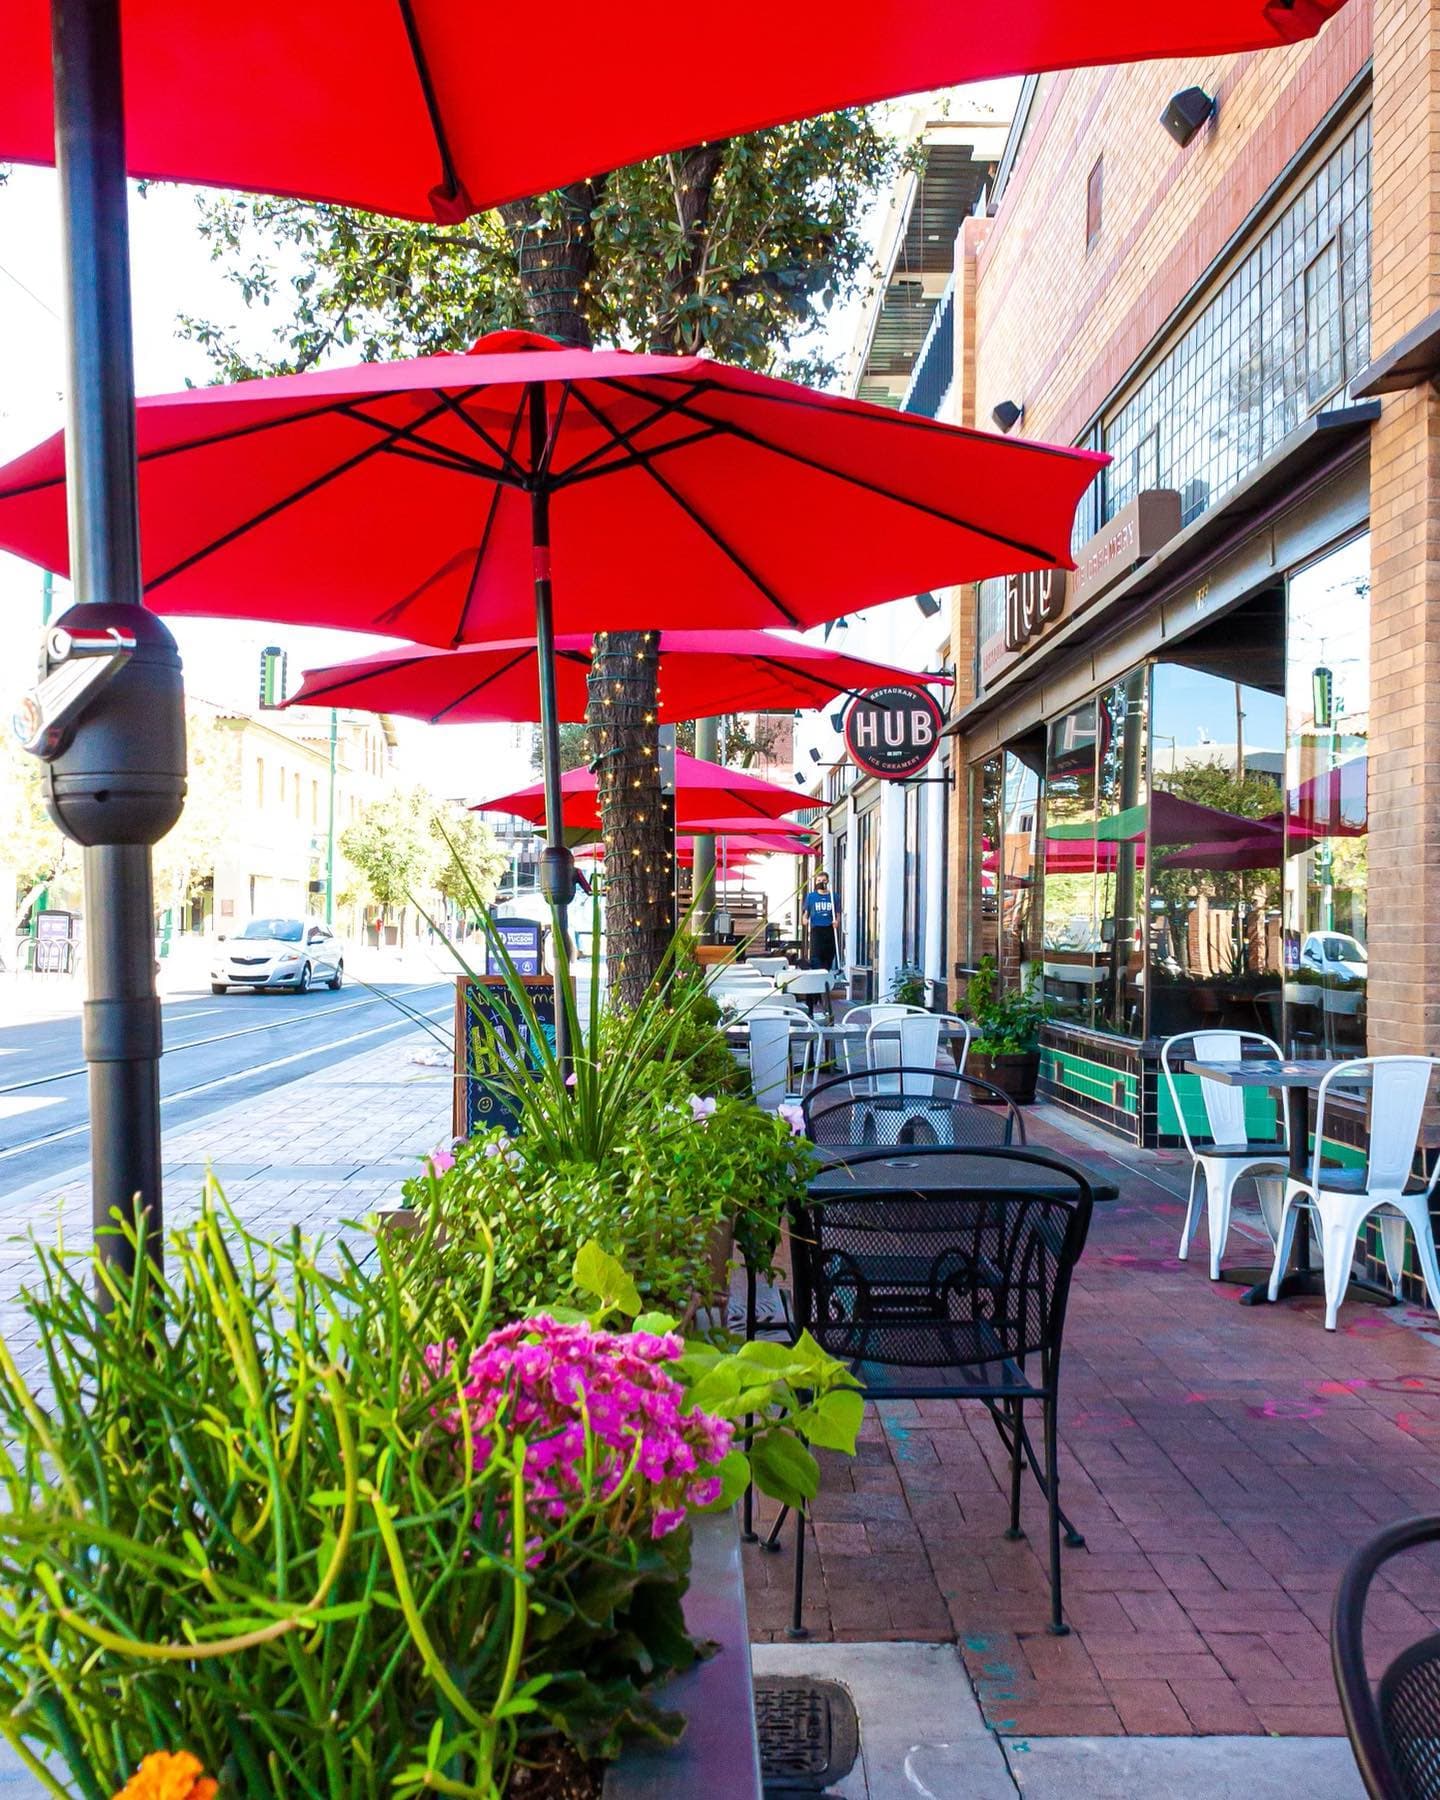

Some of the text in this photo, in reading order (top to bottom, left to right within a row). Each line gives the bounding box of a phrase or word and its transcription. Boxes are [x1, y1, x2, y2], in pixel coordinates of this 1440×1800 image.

[869, 687, 918, 700] RESTAURANT
[856, 709, 933, 748] HUB
[868, 755, 921, 769] ICE CREAMERY
[815, 901, 832, 911] HUB
